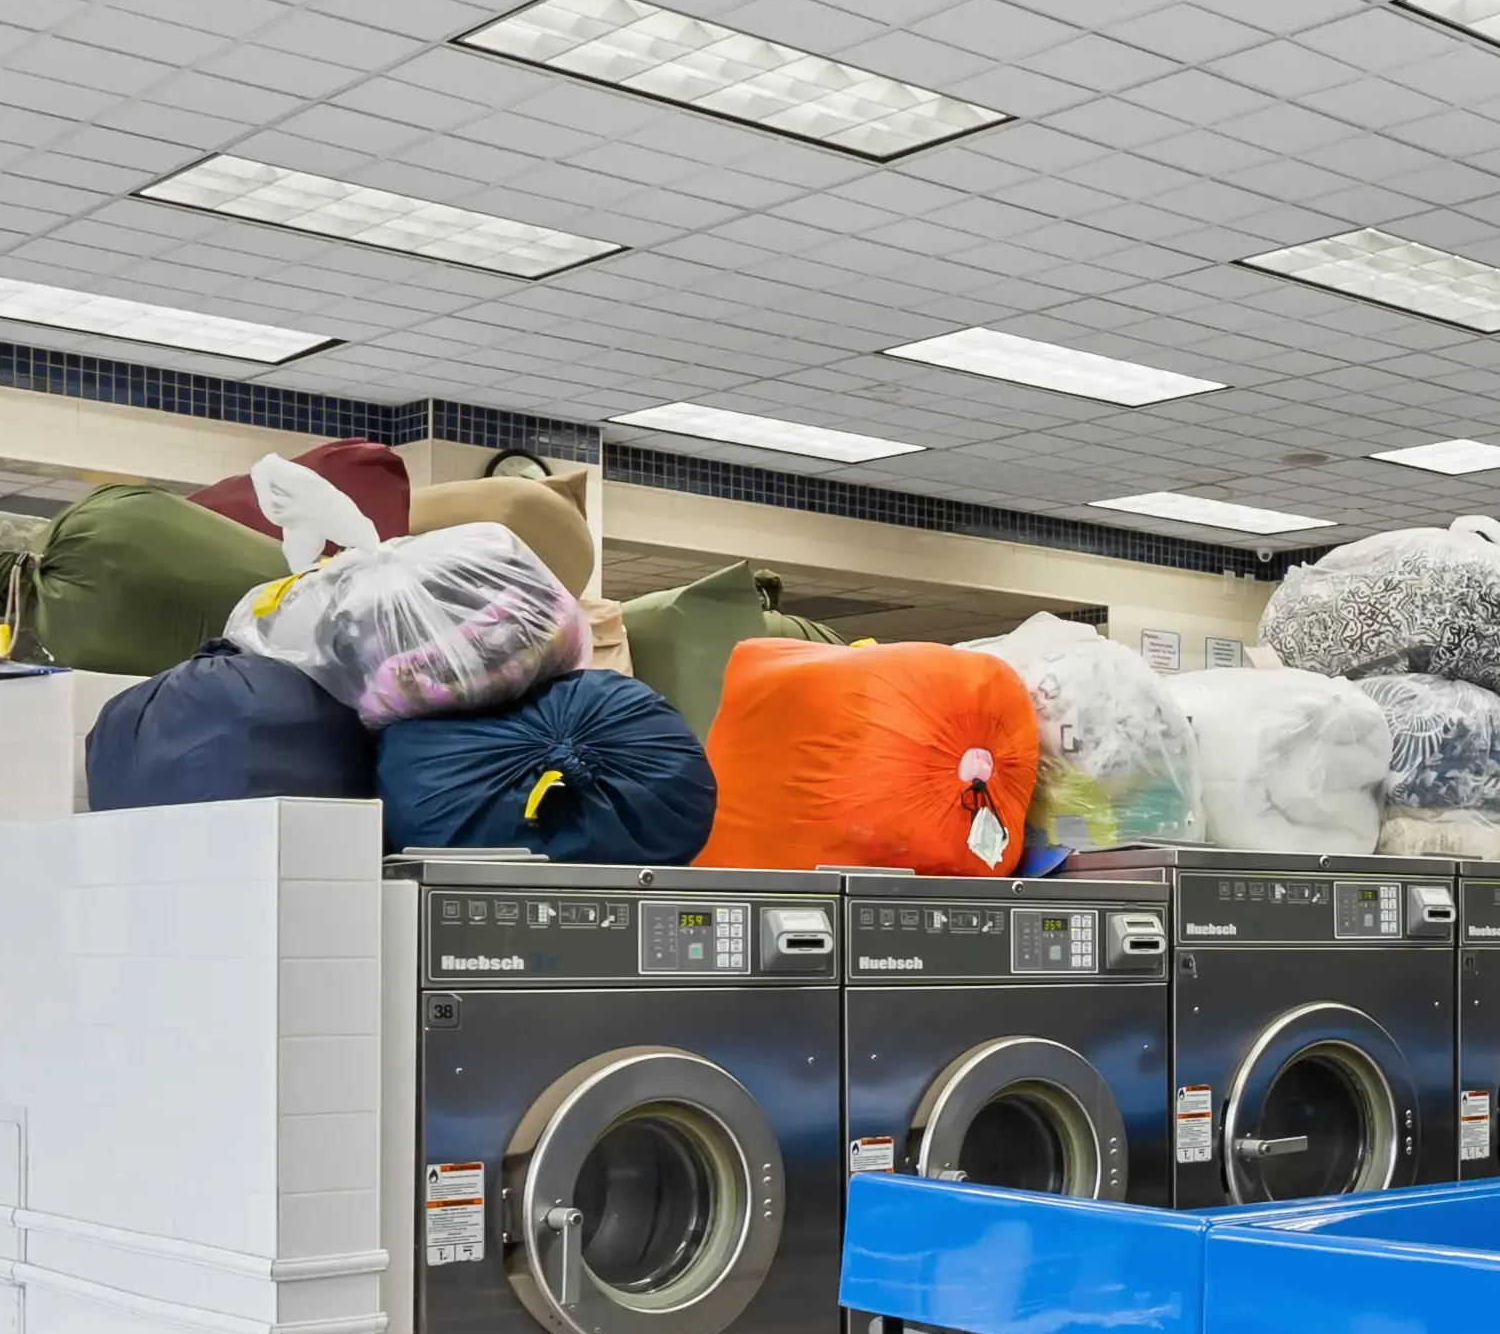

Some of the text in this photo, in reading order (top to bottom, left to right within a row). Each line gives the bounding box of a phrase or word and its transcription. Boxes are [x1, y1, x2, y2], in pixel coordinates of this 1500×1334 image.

[1186, 922, 1237, 936] Huebsch
[441, 955, 525, 971] Huebsch
[859, 956, 924, 970] Huebsch
[432, 1004, 454, 1019] 38
